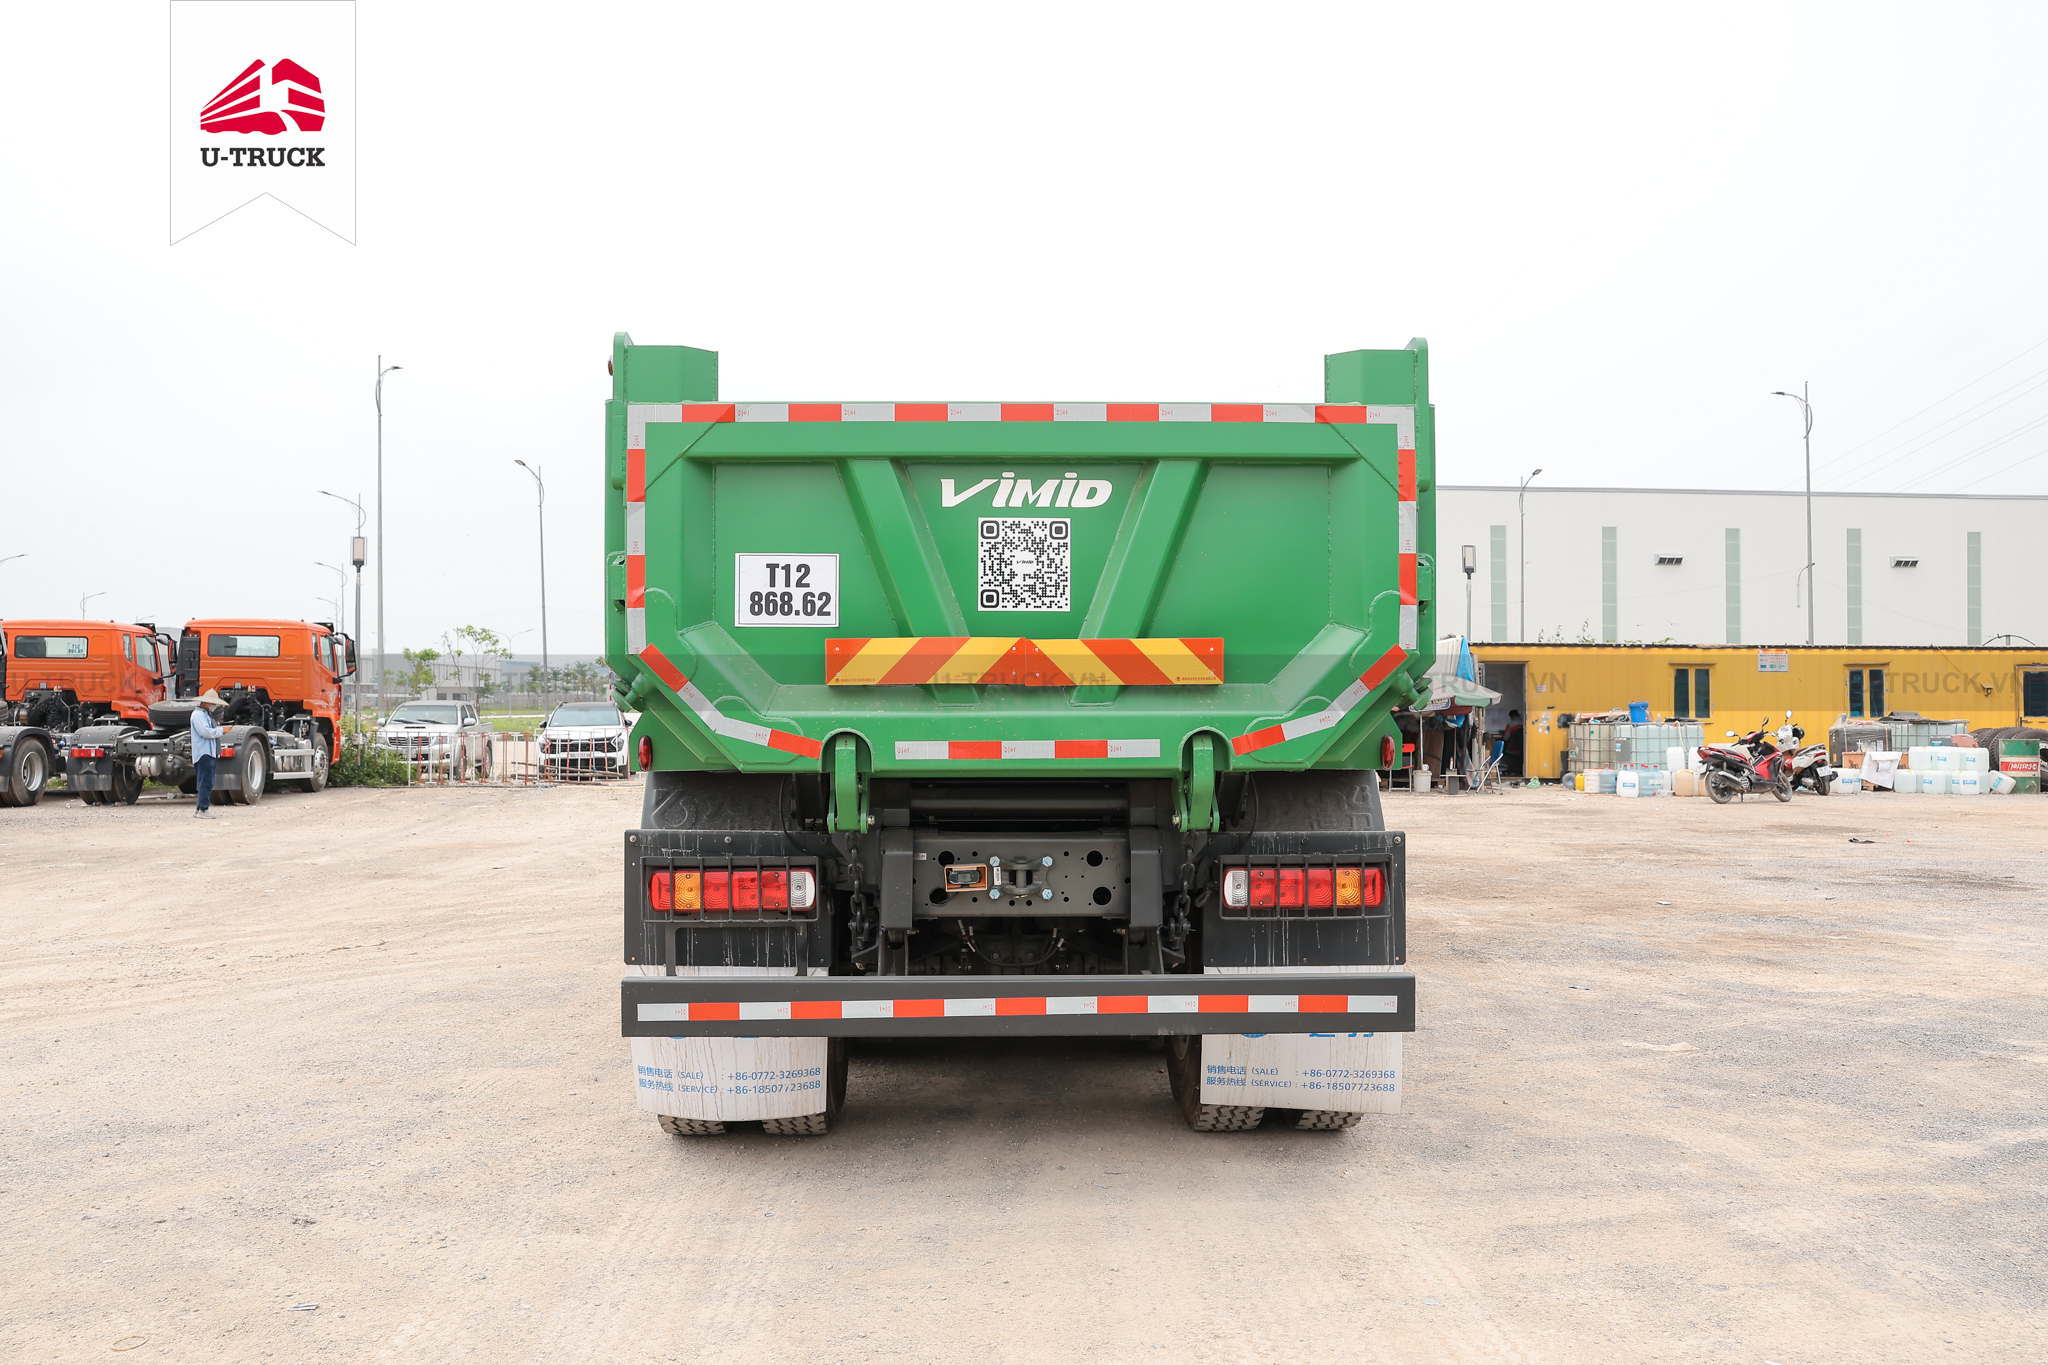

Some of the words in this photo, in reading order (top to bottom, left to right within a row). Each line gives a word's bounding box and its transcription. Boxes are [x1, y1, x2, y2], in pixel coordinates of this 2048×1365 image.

[765, 563, 811, 588] T12
[749, 591, 832, 617] 868.62
[638, 1065, 673, 1079] 销售电话
[1206, 1065, 1247, 1075] 销售电话
[639, 1078, 674, 1092] 服务热线
[1206, 1077, 1246, 1087] 服务热线
